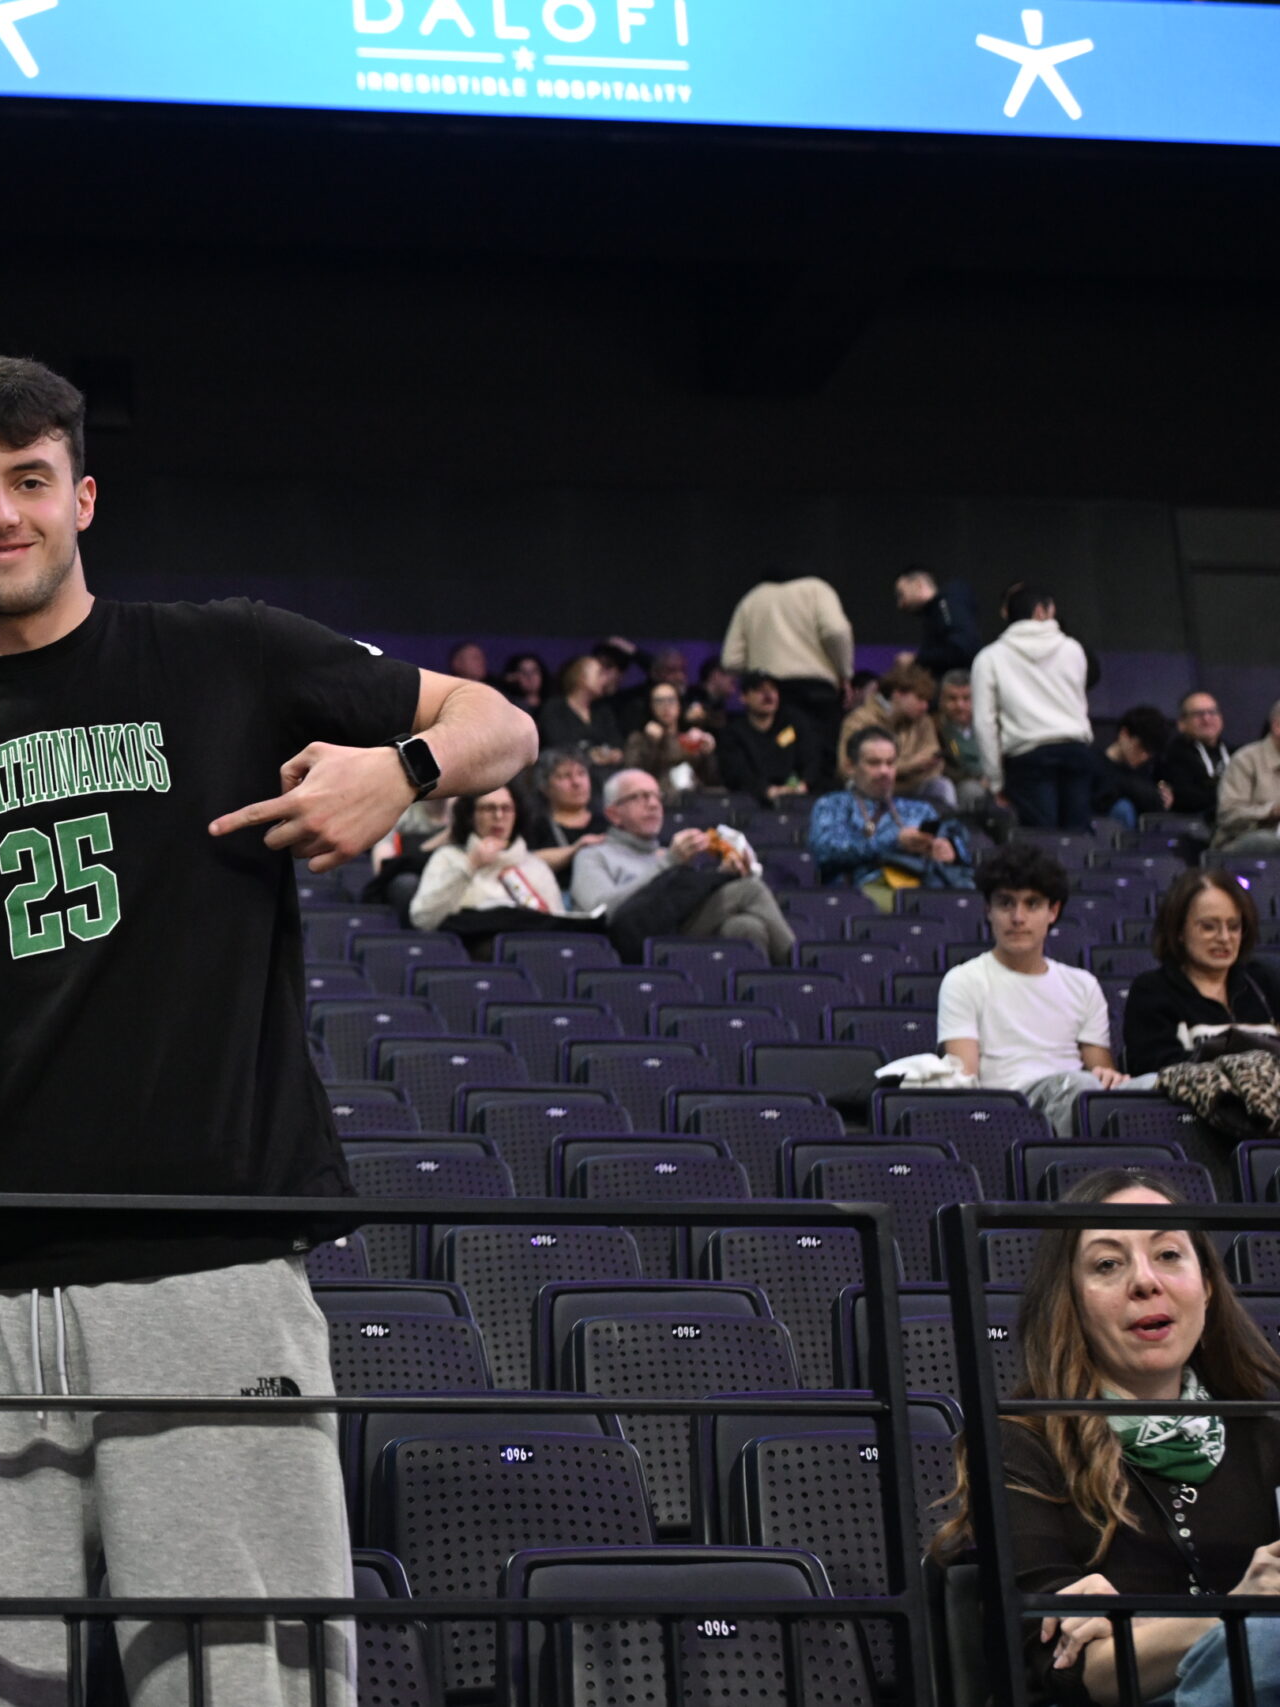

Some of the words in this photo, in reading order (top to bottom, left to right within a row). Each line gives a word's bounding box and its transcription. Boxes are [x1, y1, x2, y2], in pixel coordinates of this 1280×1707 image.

[356, 71, 527, 97] IRRESISTIBLE
[536, 79, 691, 103] HOSPITALITY
[366, 1325, 384, 1337] 096
[678, 1326, 695, 1338] 095
[257, 1377, 280, 1387] THE
[241, 1387, 280, 1397] NORTH
[506, 1447, 527, 1461] 096
[866, 1447, 879, 1460] 09
[704, 1621, 729, 1636] 096
